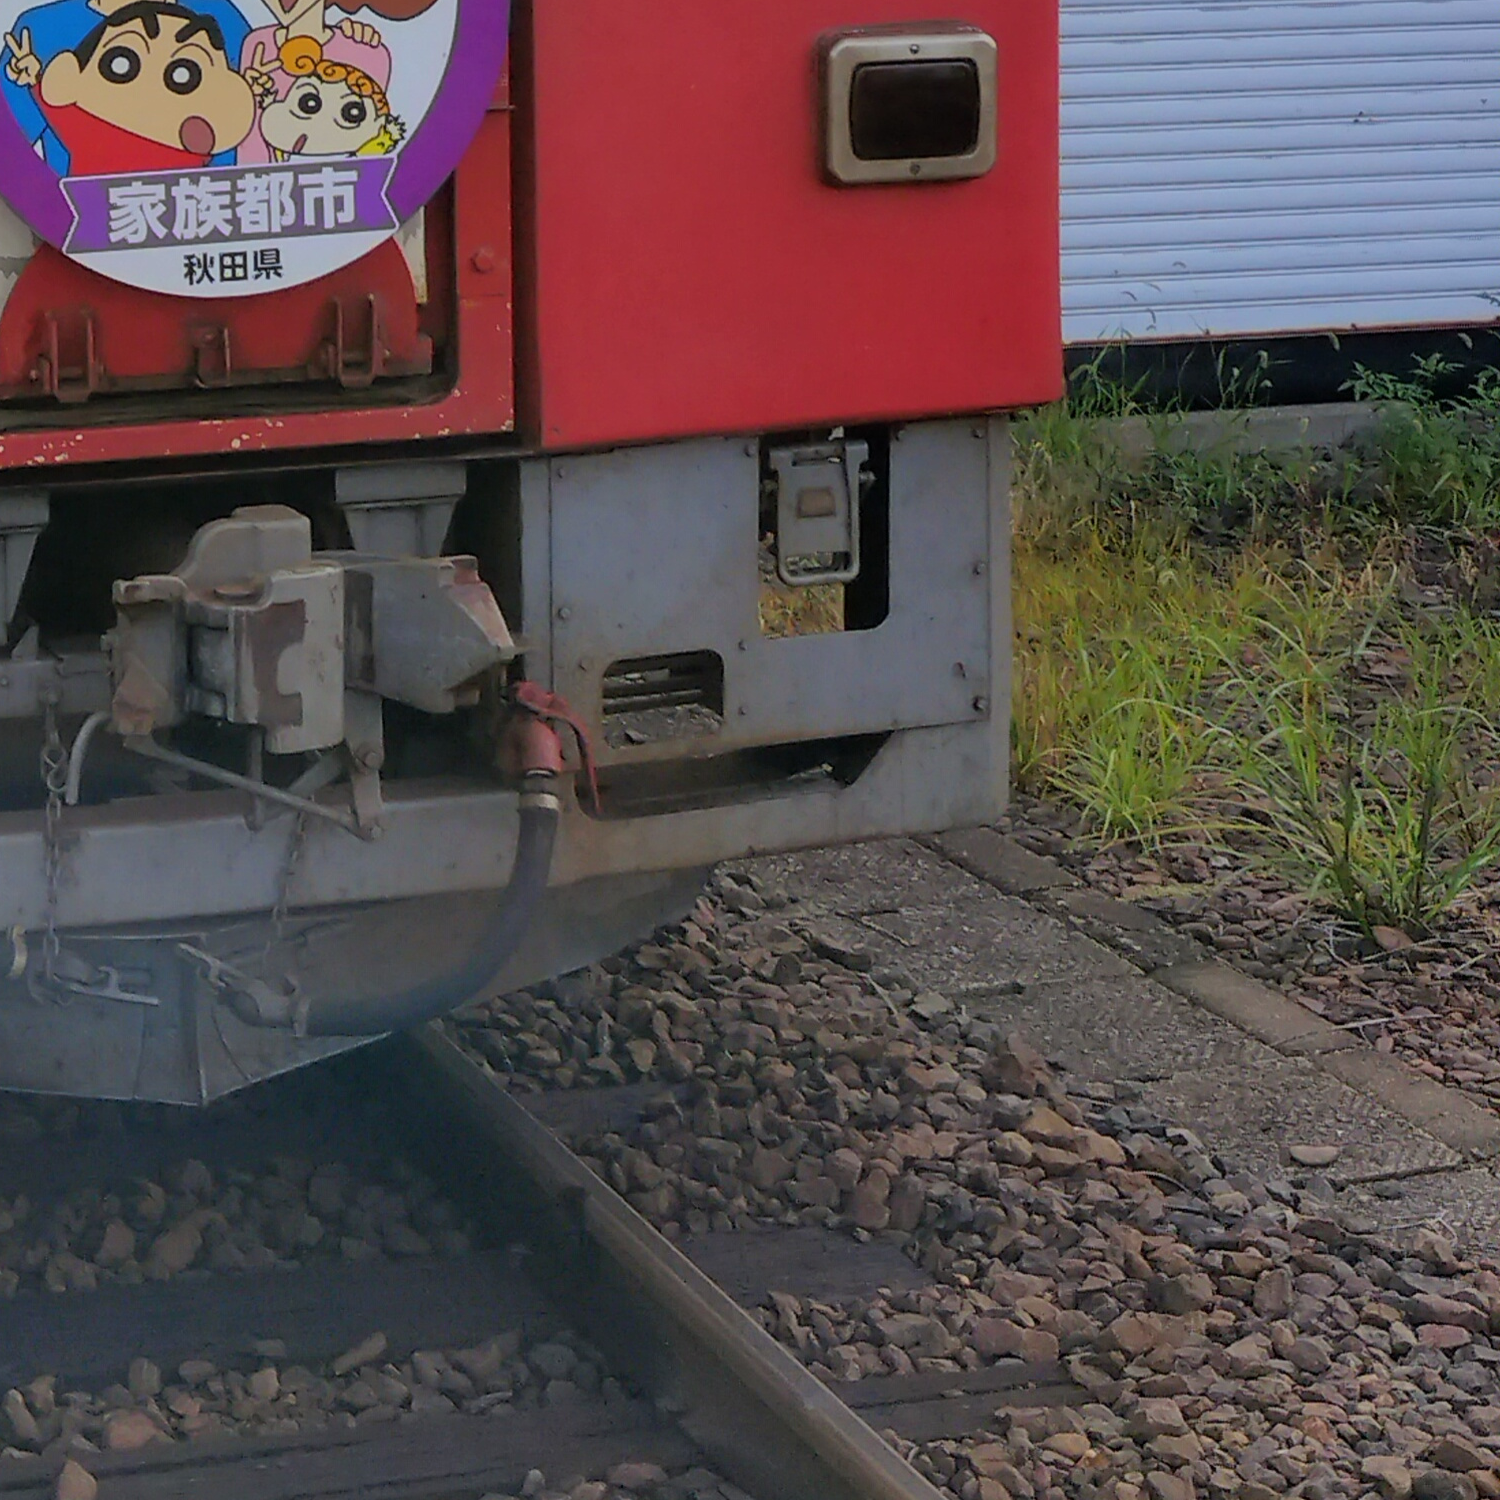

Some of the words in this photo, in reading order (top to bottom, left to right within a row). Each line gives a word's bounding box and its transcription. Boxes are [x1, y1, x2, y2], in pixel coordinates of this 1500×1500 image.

[108, 166, 358, 244] 家族都市
[183, 248, 283, 286] 秋田県
